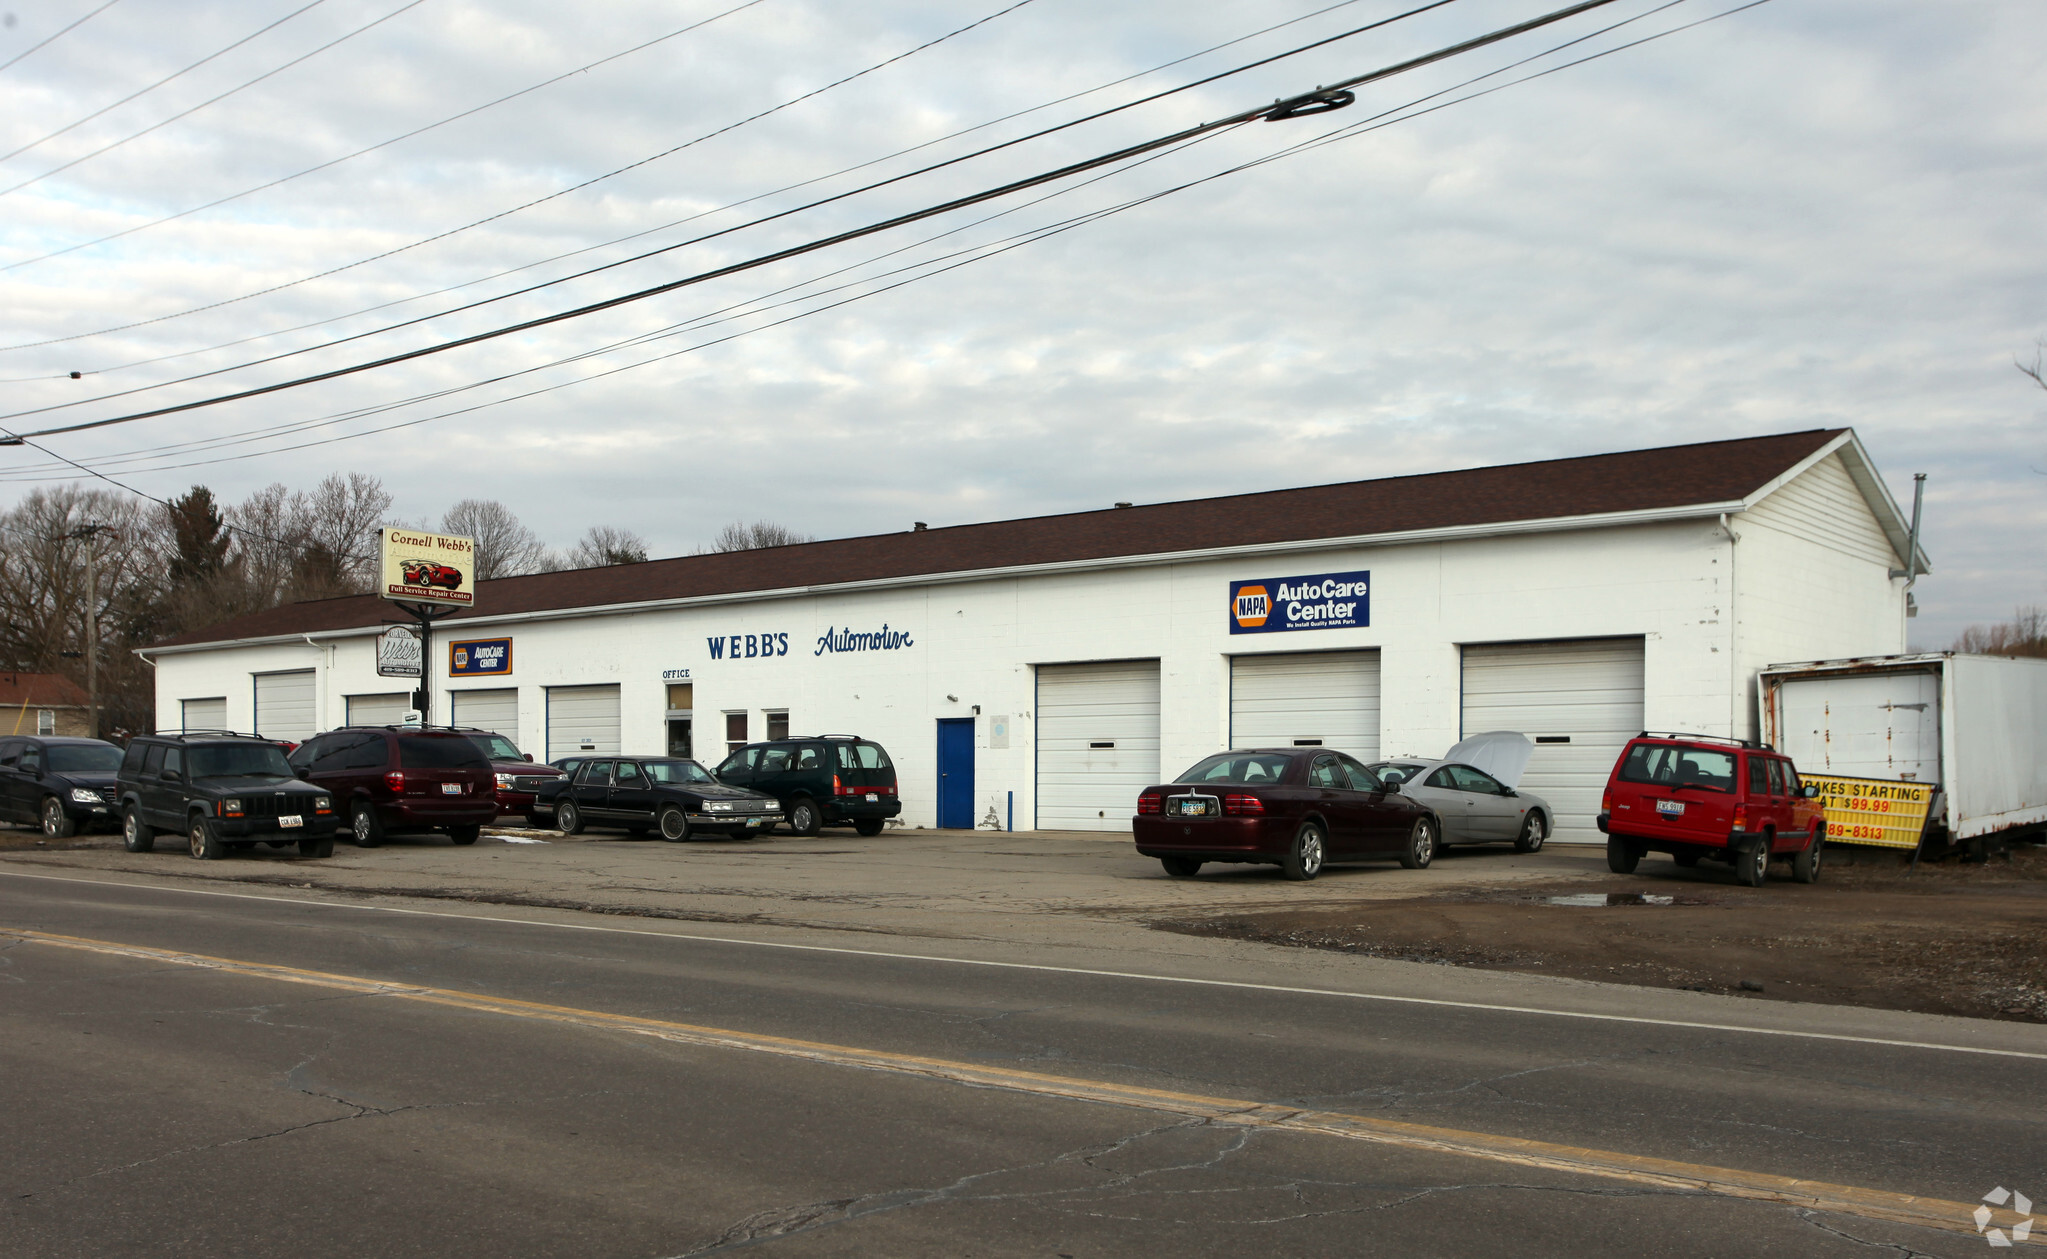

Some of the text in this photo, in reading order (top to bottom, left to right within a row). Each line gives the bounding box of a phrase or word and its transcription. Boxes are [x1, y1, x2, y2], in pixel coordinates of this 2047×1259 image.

[391, 532, 472, 552] Cornell Webb's
[391, 585, 470, 600] Full Service Repair Center
[1276, 579, 1367, 601] AutoCare
[1238, 596, 1266, 616] NAPA
[1286, 600, 1356, 621] Center
[707, 632, 789, 660] WEBB'S
[814, 623, 914, 656] Automotive
[456, 653, 466, 664] NAPA
[480, 658, 498, 668] CENTER
[663, 669, 690, 679] OFFICE
[1853, 784, 1920, 800] STARTING
[1819, 795, 1889, 812] AT $99.99
[1823, 824, 1882, 839] 89-8313
